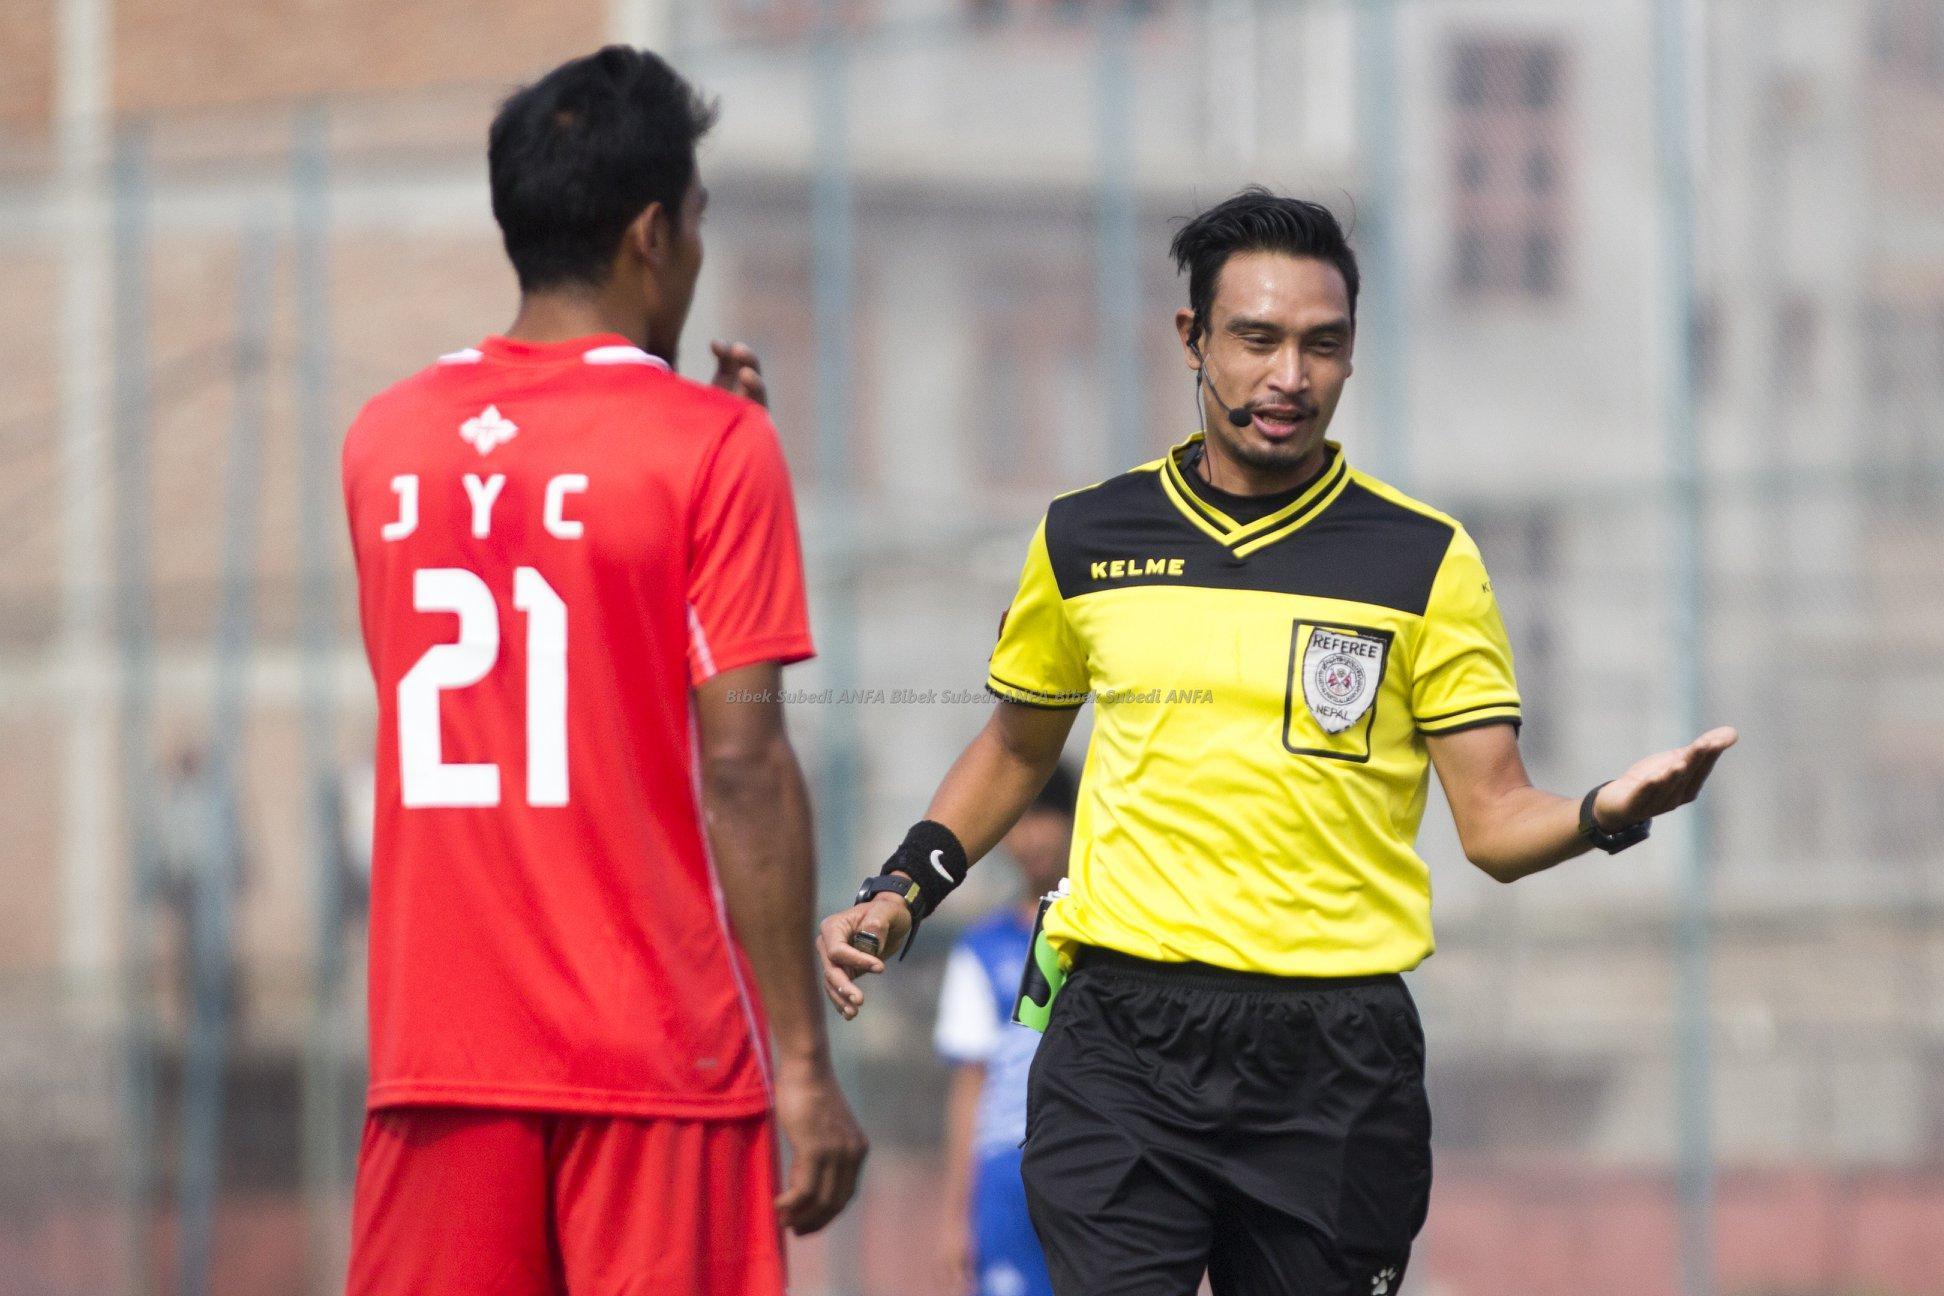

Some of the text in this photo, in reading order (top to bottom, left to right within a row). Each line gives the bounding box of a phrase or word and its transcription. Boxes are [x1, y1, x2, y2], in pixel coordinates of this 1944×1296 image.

[1090, 558, 1185, 579] KELME
[1312, 633, 1379, 659] REFEREE
[396, 565, 570, 809] 21
[1315, 703, 1352, 721] NEPAL
